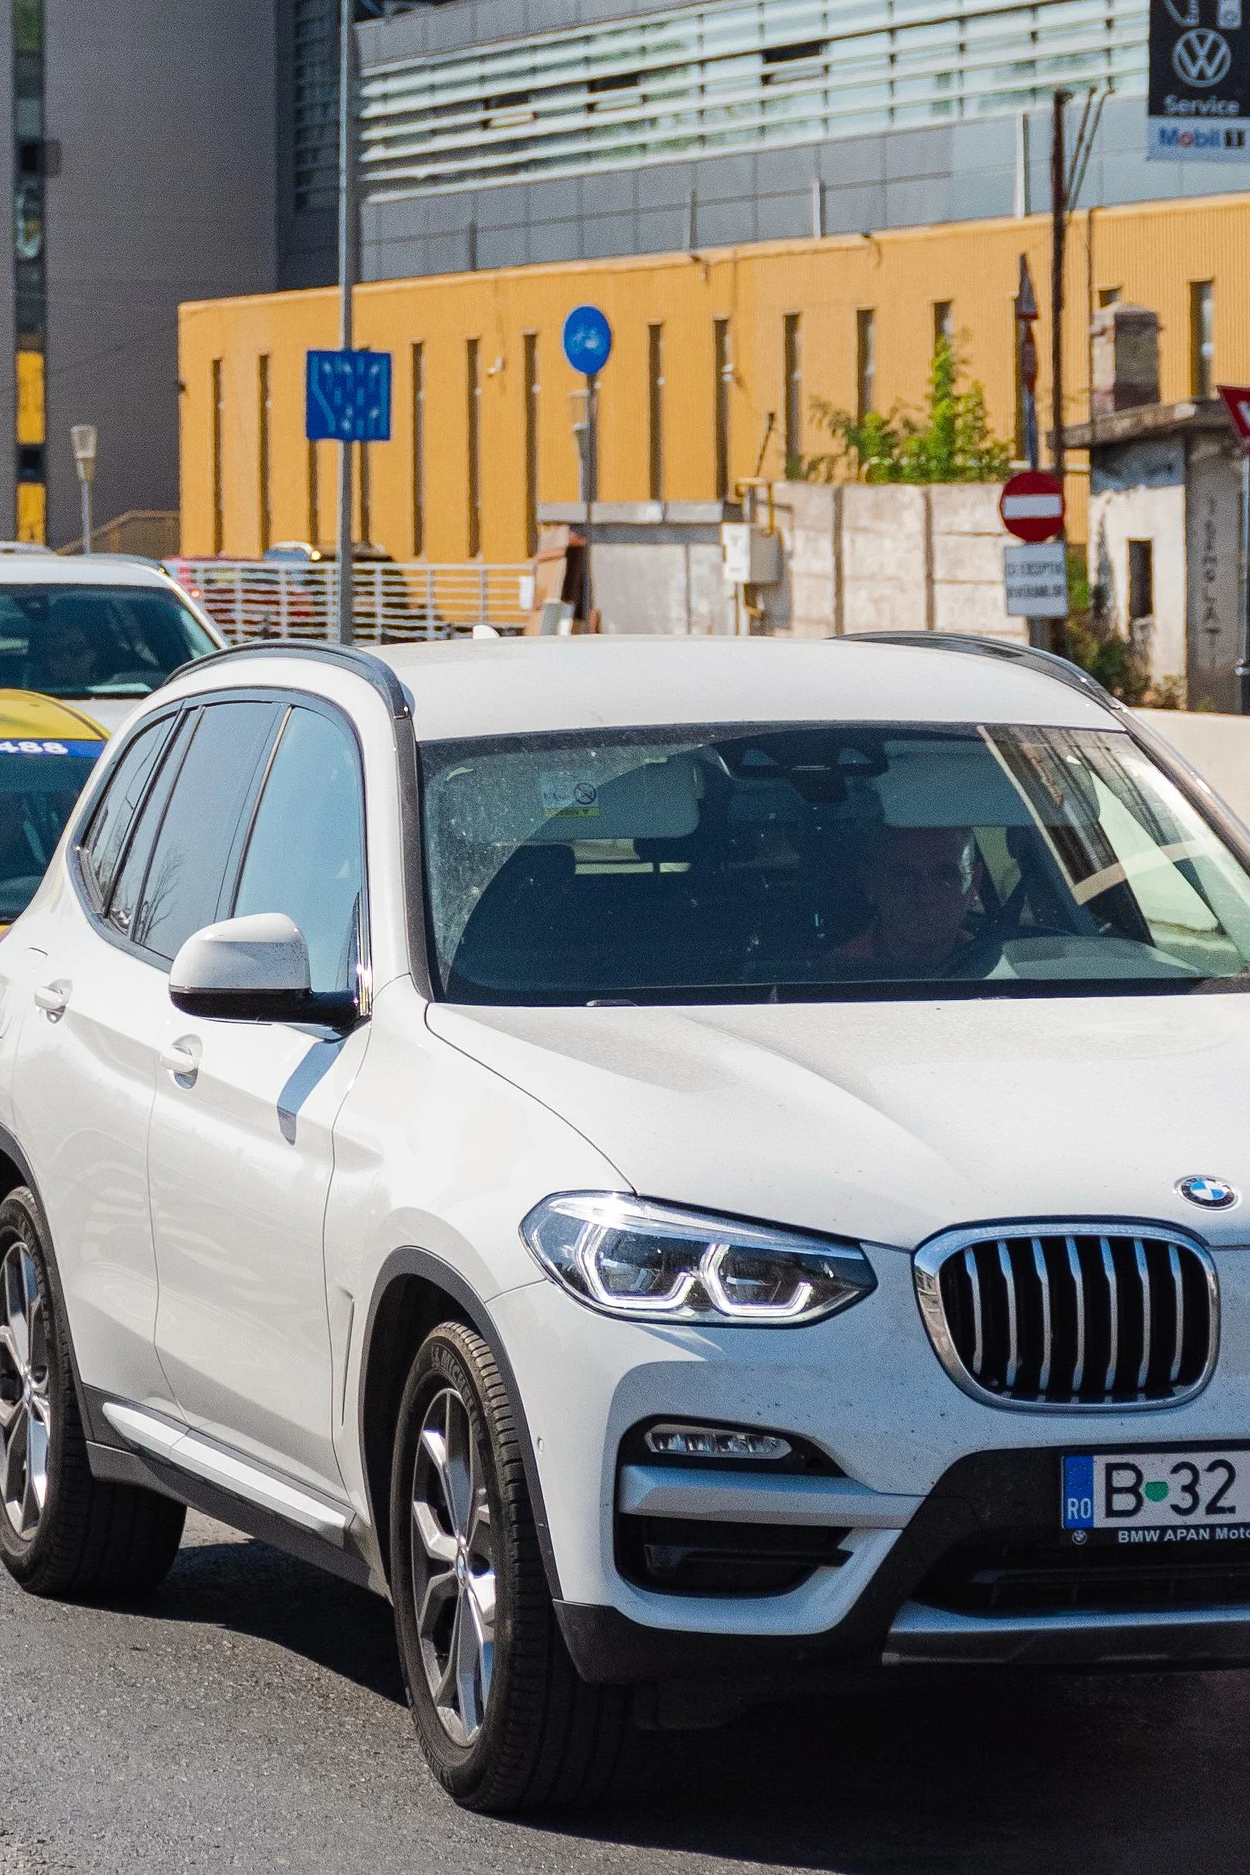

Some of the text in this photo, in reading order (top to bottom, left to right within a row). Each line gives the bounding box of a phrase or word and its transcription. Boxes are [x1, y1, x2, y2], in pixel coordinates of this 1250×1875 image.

[1163, 94, 1240, 115] Service
[1158, 127, 1221, 148] Mobil
[1104, 1458, 1237, 1518] B 32
[1066, 1498, 1092, 1520] RO
[1118, 1530, 1160, 1543] BMW
[1163, 1528, 1210, 1542] APAN
